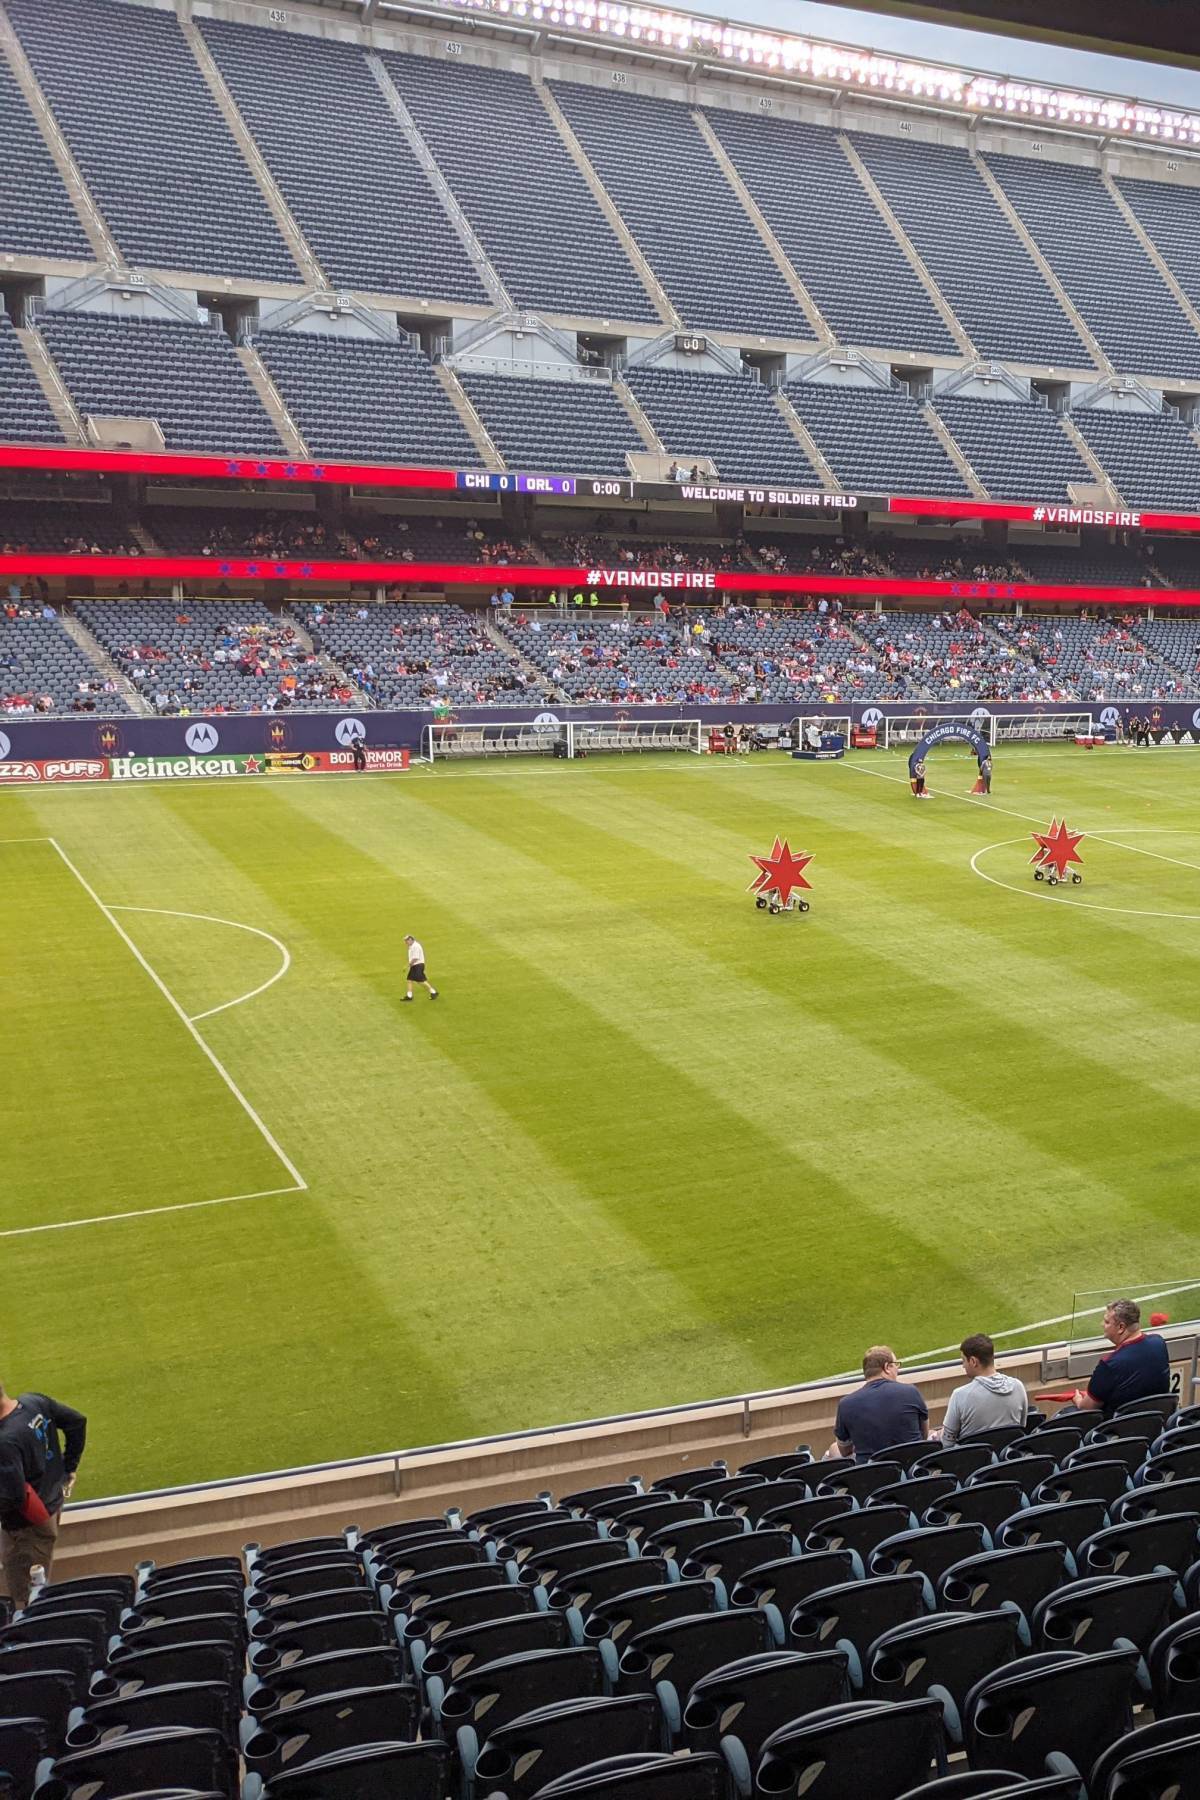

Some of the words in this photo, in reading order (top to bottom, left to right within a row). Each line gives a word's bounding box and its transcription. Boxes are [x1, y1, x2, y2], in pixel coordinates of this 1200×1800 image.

[270, 10, 286, 22] 436
[447, 42, 461, 54] 437
[612, 73, 626, 83] 438
[760, 99, 772, 109] 439
[900, 122, 912, 132] 440
[1032, 143, 1043, 152] 441
[1167, 161, 1178, 172] 442
[465, 474, 490, 488] CHI
[500, 477, 508, 489] 0
[527, 478, 553, 491] ORL
[562, 481, 570, 493] 0
[593, 482, 621, 495] 0:00
[681, 486, 745, 501] WELCOME
[749, 490, 765, 502] TO
[768, 491, 820, 506] SOLDIER
[824, 495, 858, 508] FIELD
[1033, 507, 1141, 526] #VAMOSFIRE
[586, 570, 716, 588] #VAMOSFIRE
[925, 726, 955, 745] CHICAGO
[956, 726, 972, 738] FIRE
[971, 734, 981, 744] FC
[329, 751, 402, 764] BODARMOR
[46, 762, 101, 777] PUFF
[112, 756, 238, 779] Heineken
